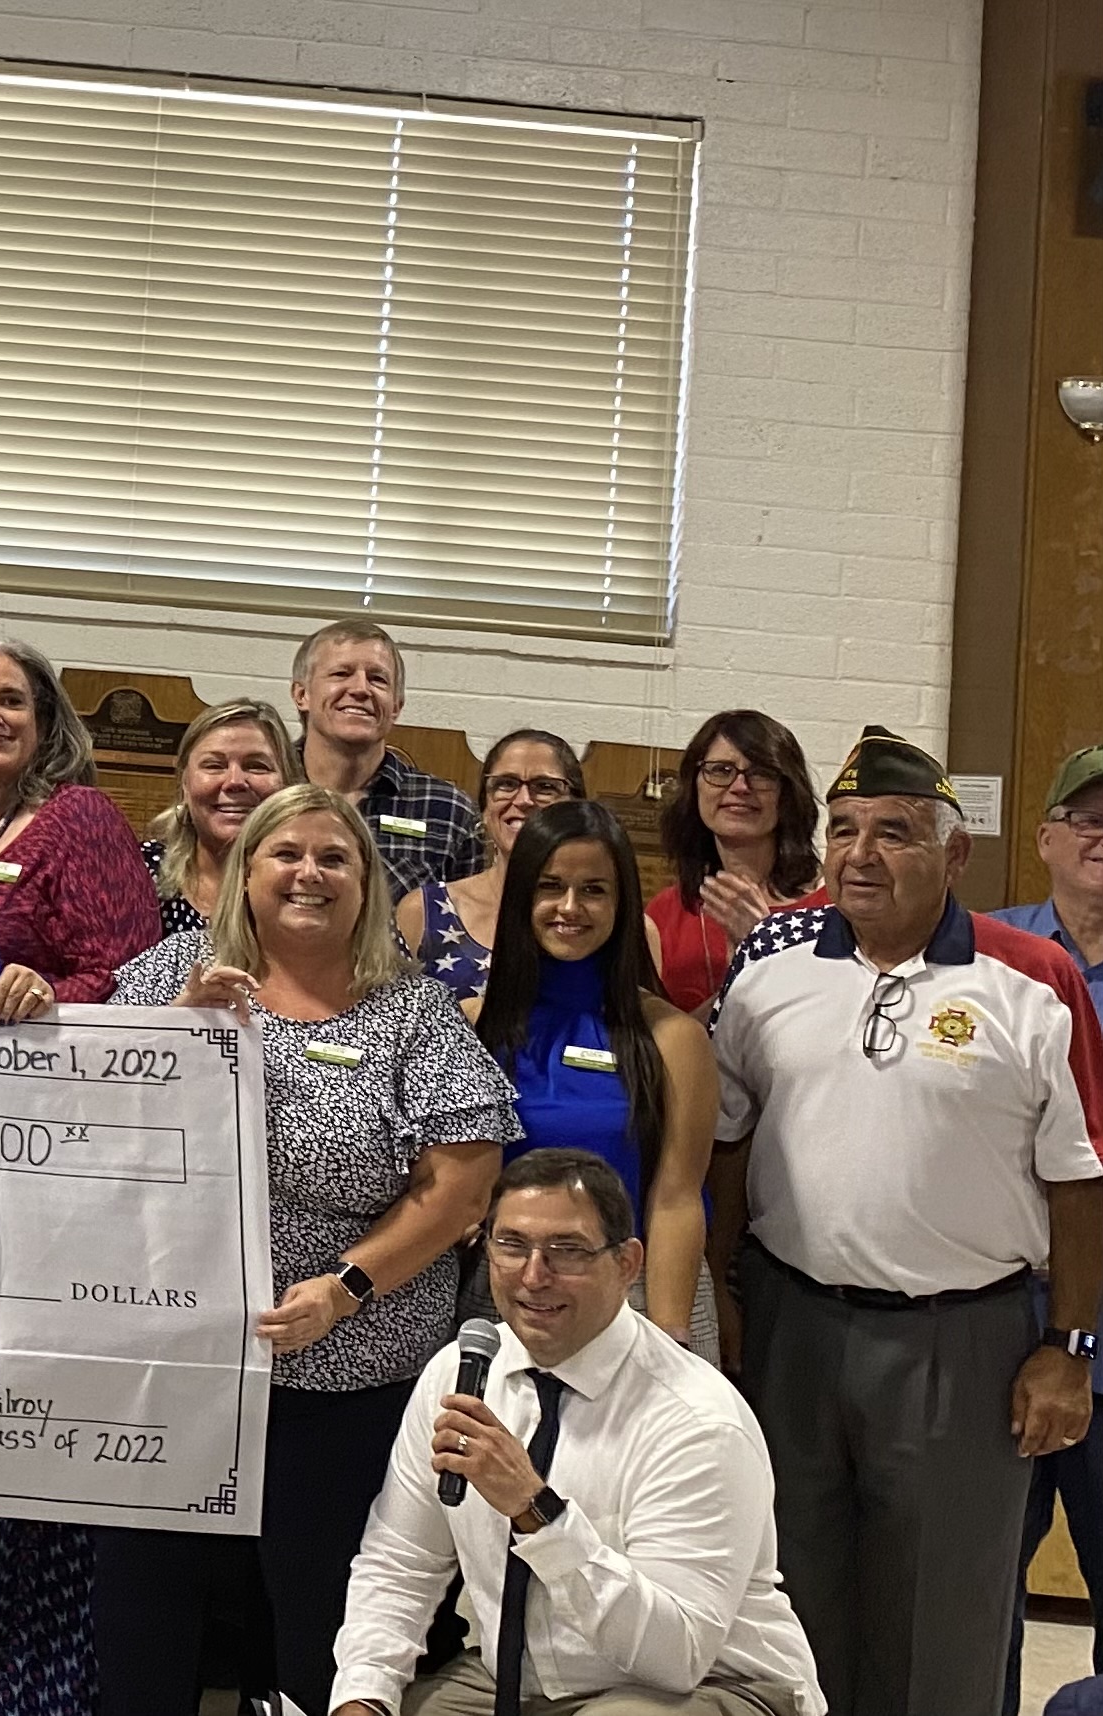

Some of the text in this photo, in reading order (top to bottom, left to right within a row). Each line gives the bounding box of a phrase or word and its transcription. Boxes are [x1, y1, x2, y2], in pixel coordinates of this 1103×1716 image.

[70, 1045, 86, 1079] 1,
[101, 1049, 181, 1081] 2022
[71, 1282, 197, 1309] DOLLARS
[54, 1429, 79, 1458] of
[93, 1432, 168, 1464] 2022
